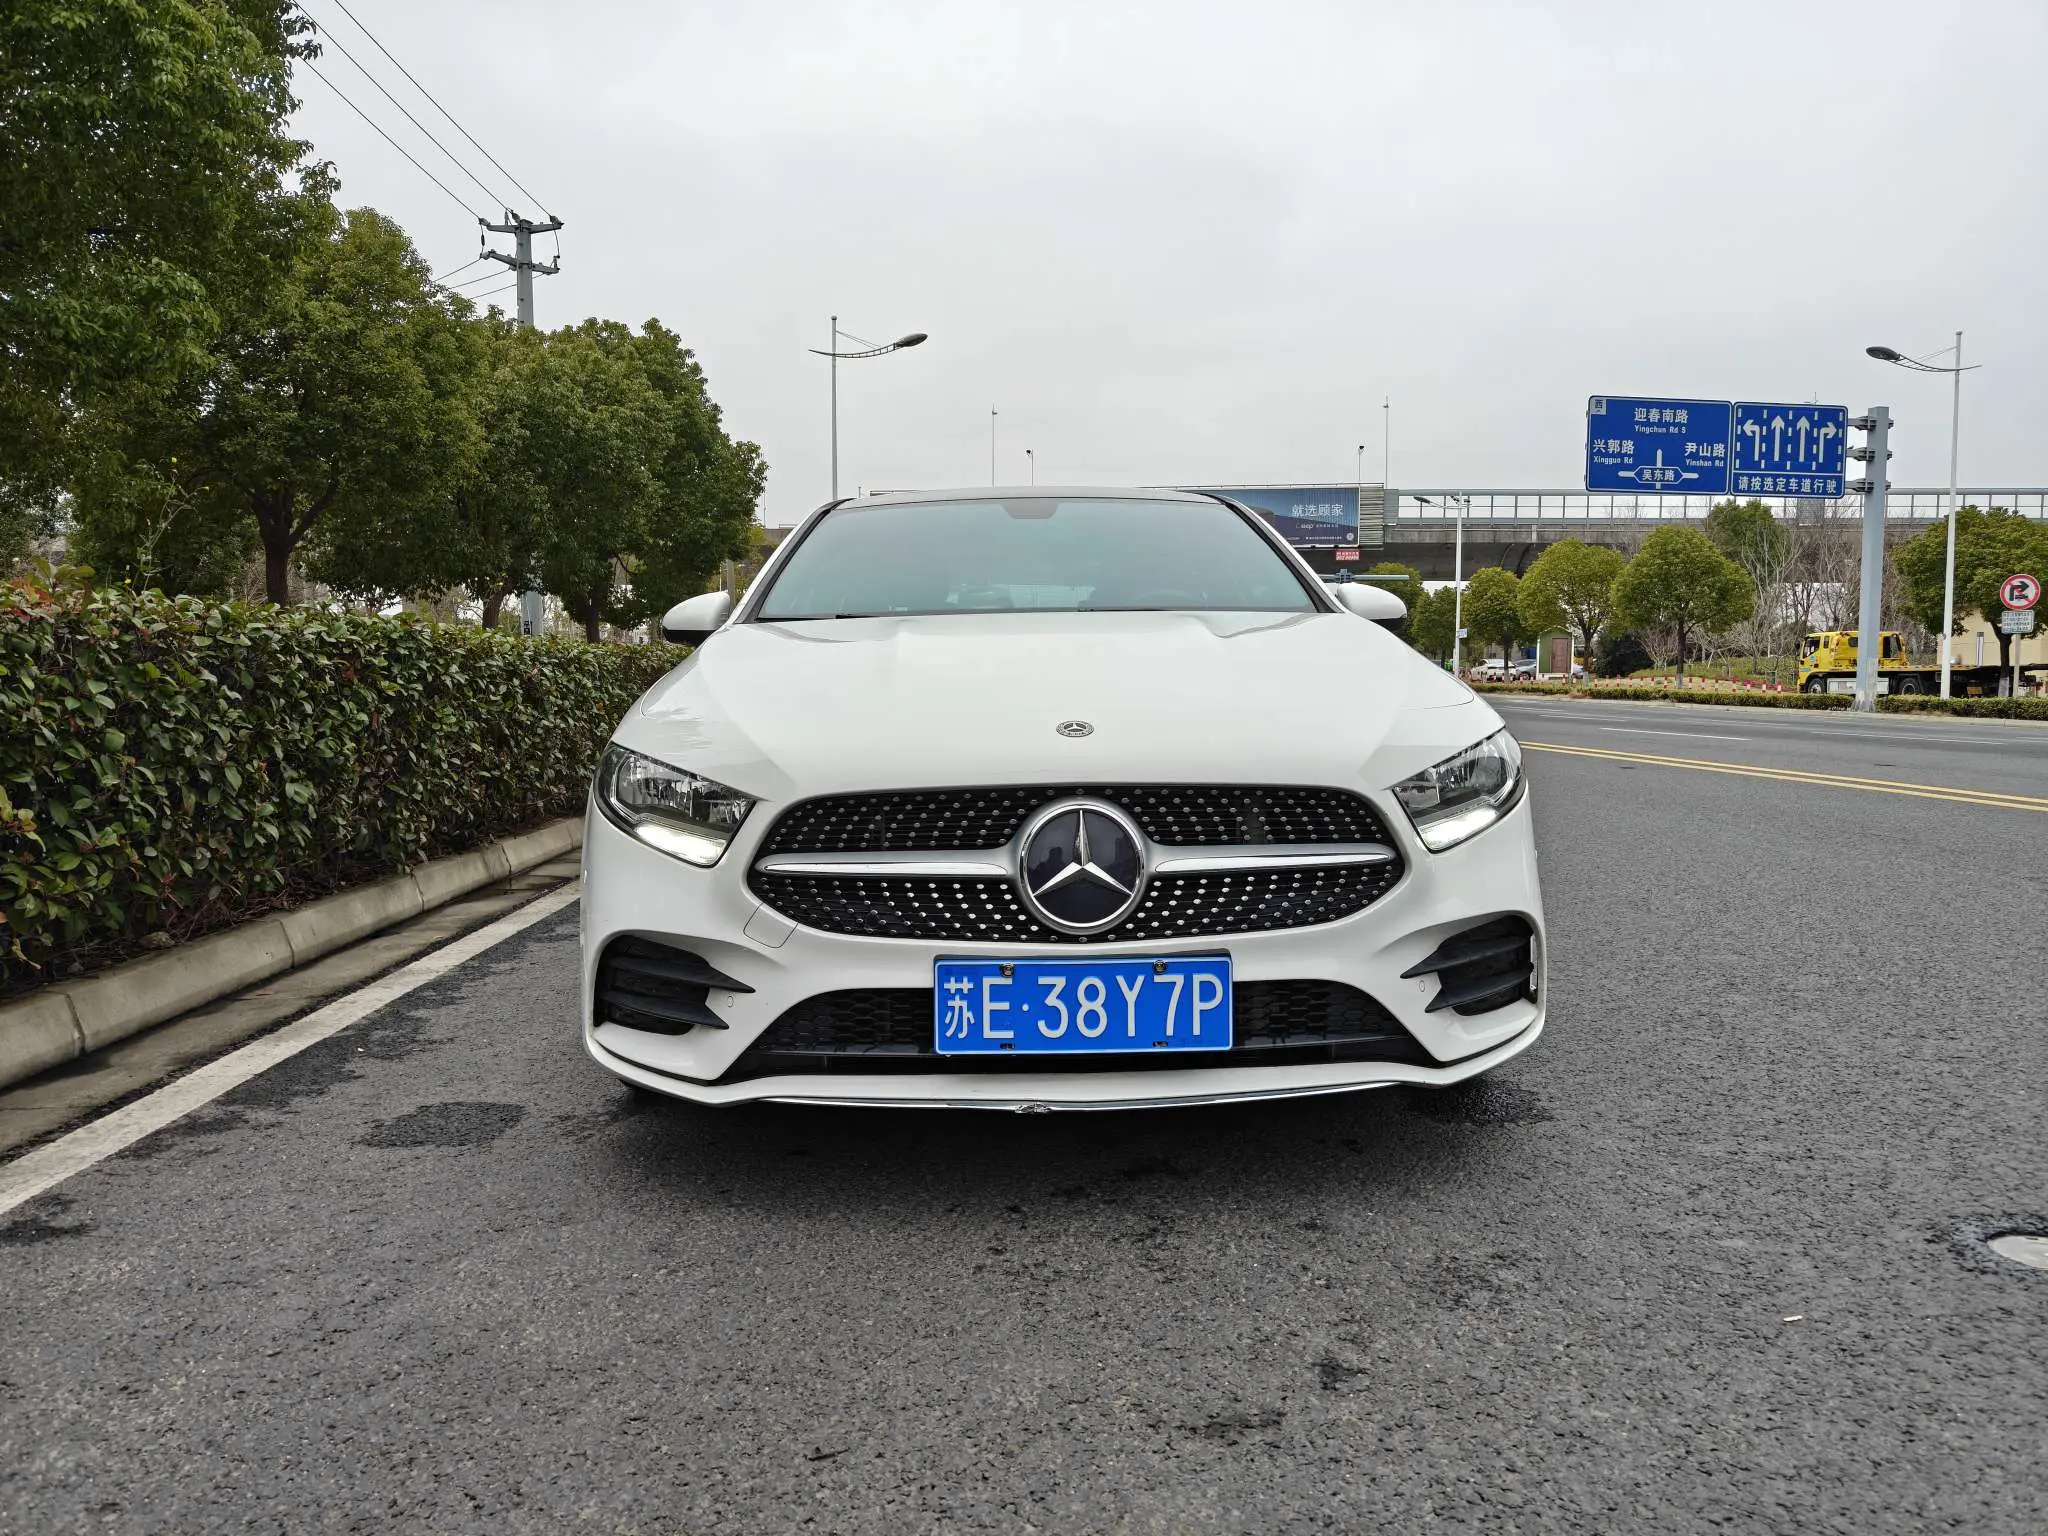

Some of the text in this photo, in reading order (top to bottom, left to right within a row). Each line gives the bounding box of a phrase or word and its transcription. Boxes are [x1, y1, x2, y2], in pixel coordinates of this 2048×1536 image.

[1634, 407, 1689, 424] 迎春南路
[1634, 425, 1667, 434] Yingchun
[1681, 426, 1686, 434] S
[1593, 439, 1634, 454] 兴郭路
[1684, 442, 1726, 457] 尹山路
[1593, 455, 1633, 464] Xingguo Rd
[1685, 458, 1712, 466] Yinshan
[1642, 469, 1675, 481] 吴东路
[1738, 475, 1837, 494] 请按选定车道行驶
[1292, 504, 1344, 517] 就选顾家
[943, 973, 1223, 1039] 苏E·38Y7P
